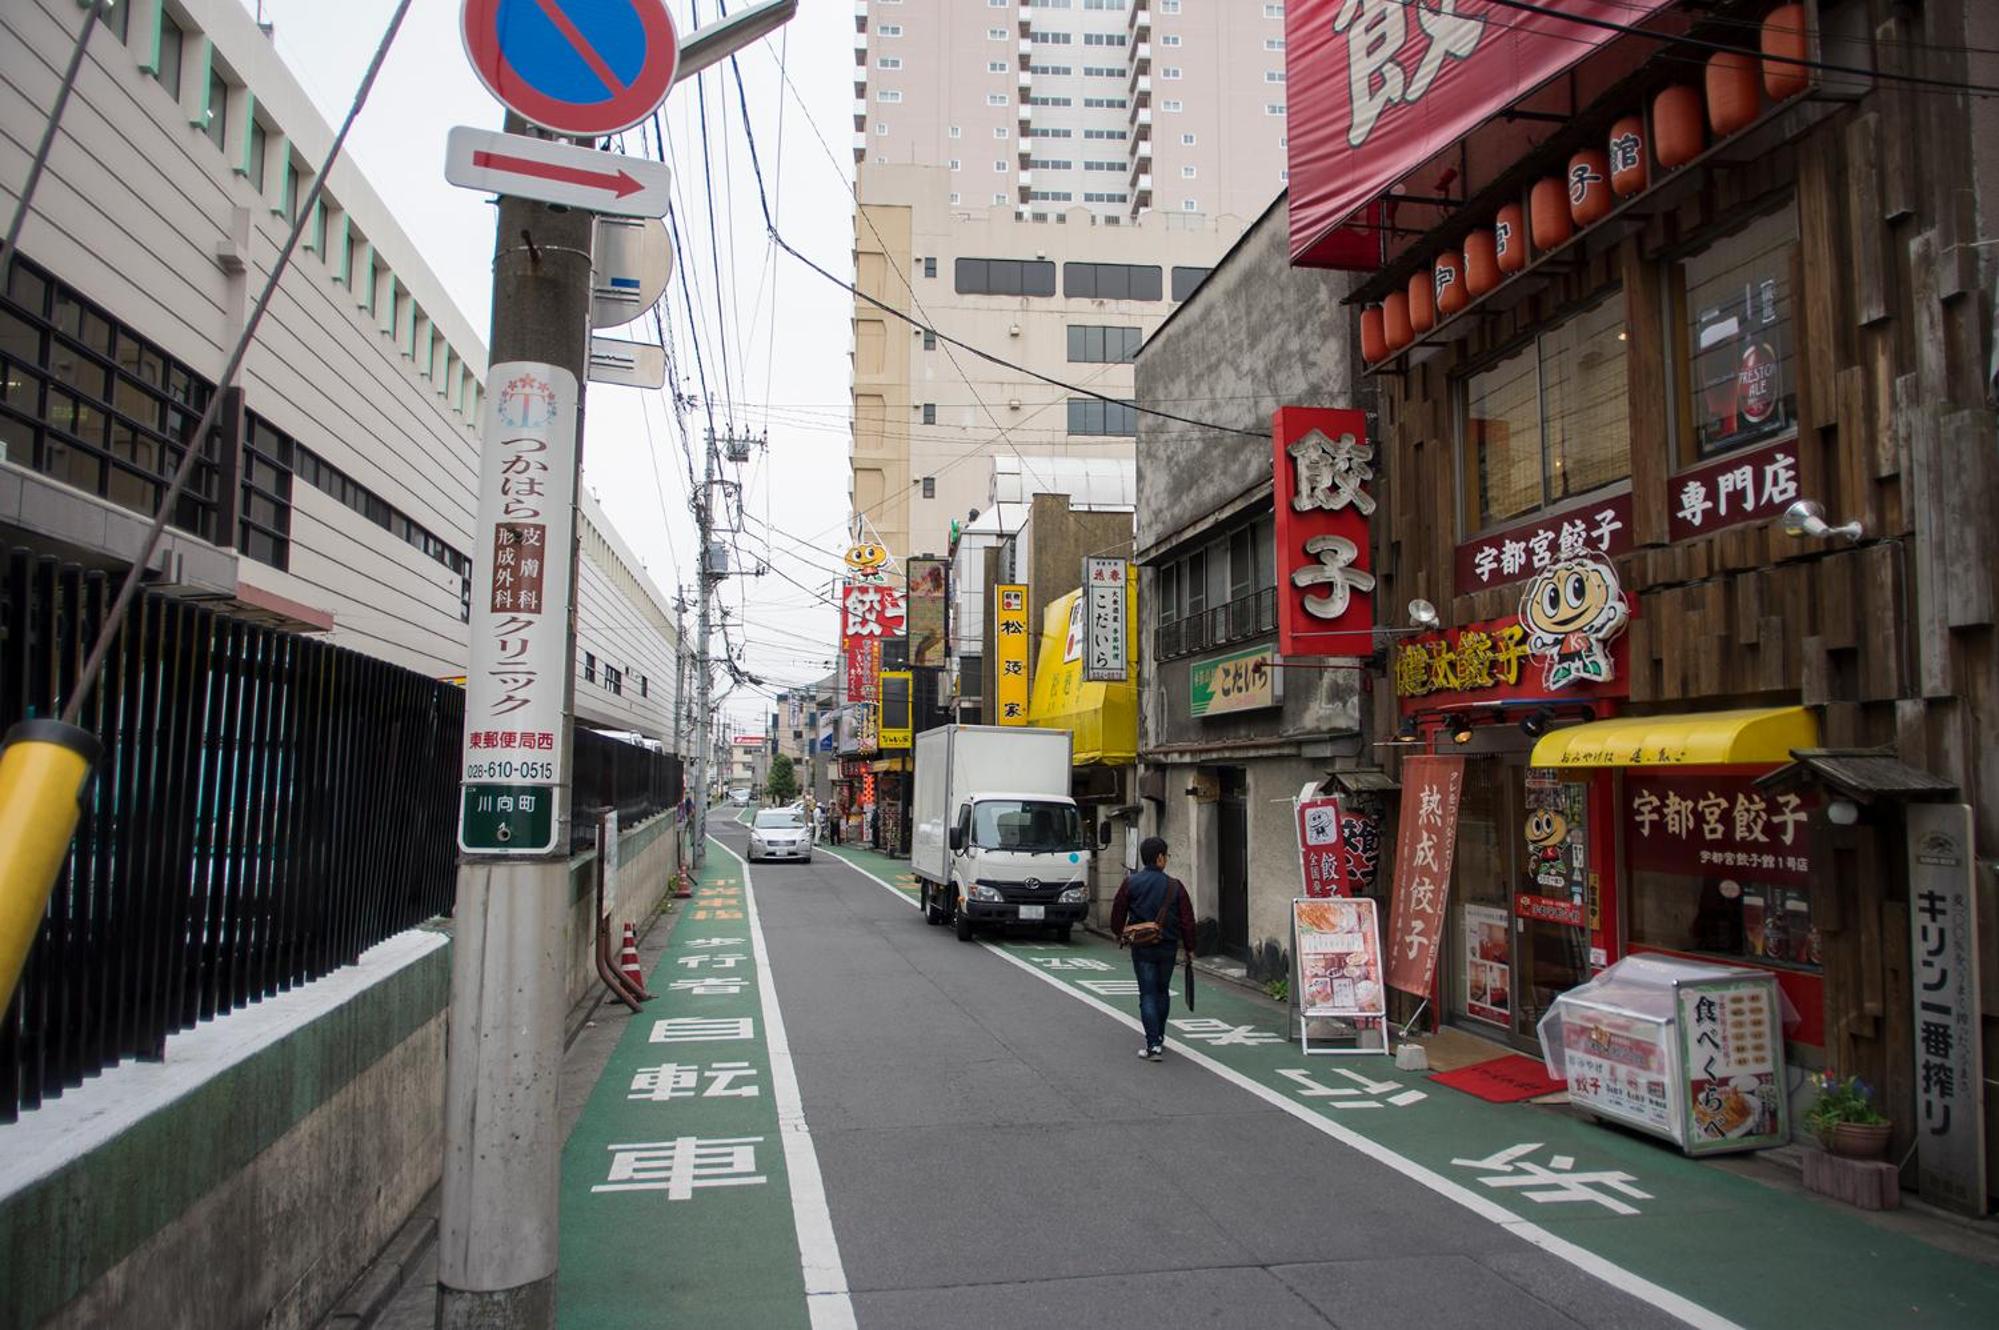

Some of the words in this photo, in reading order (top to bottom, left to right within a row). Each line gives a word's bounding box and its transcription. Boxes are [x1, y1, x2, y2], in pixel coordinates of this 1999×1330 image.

[1748, 379, 1767, 398] ALE
[500, 437, 549, 518] つかはら
[1675, 453, 1798, 527] 専門店
[1286, 428, 1376, 620] 餃子
[1474, 508, 1623, 582] 宇都宮餃子
[495, 527, 516, 609] 形成外科
[518, 527, 541, 609] 皮膚科
[489, 616, 539, 716] クリニック
[1095, 594, 1109, 667] こだいら
[1397, 623, 1531, 697] 健太餃子
[1221, 657, 1268, 697] こだいら
[467, 762, 553, 780] 028-610-0515
[468, 732, 554, 751] 東郵便局西
[477, 794, 536, 813] 川向町
[1633, 790, 1809, 846] 宇都宮餃子
[1404, 784, 1442, 960] 熟成餃子
[1699, 850, 1809, 872] 宇都宮餃子館1号店
[1918, 889, 1955, 1137] キリン一番搾り
[1694, 995, 1727, 1139] 食べくらべ
